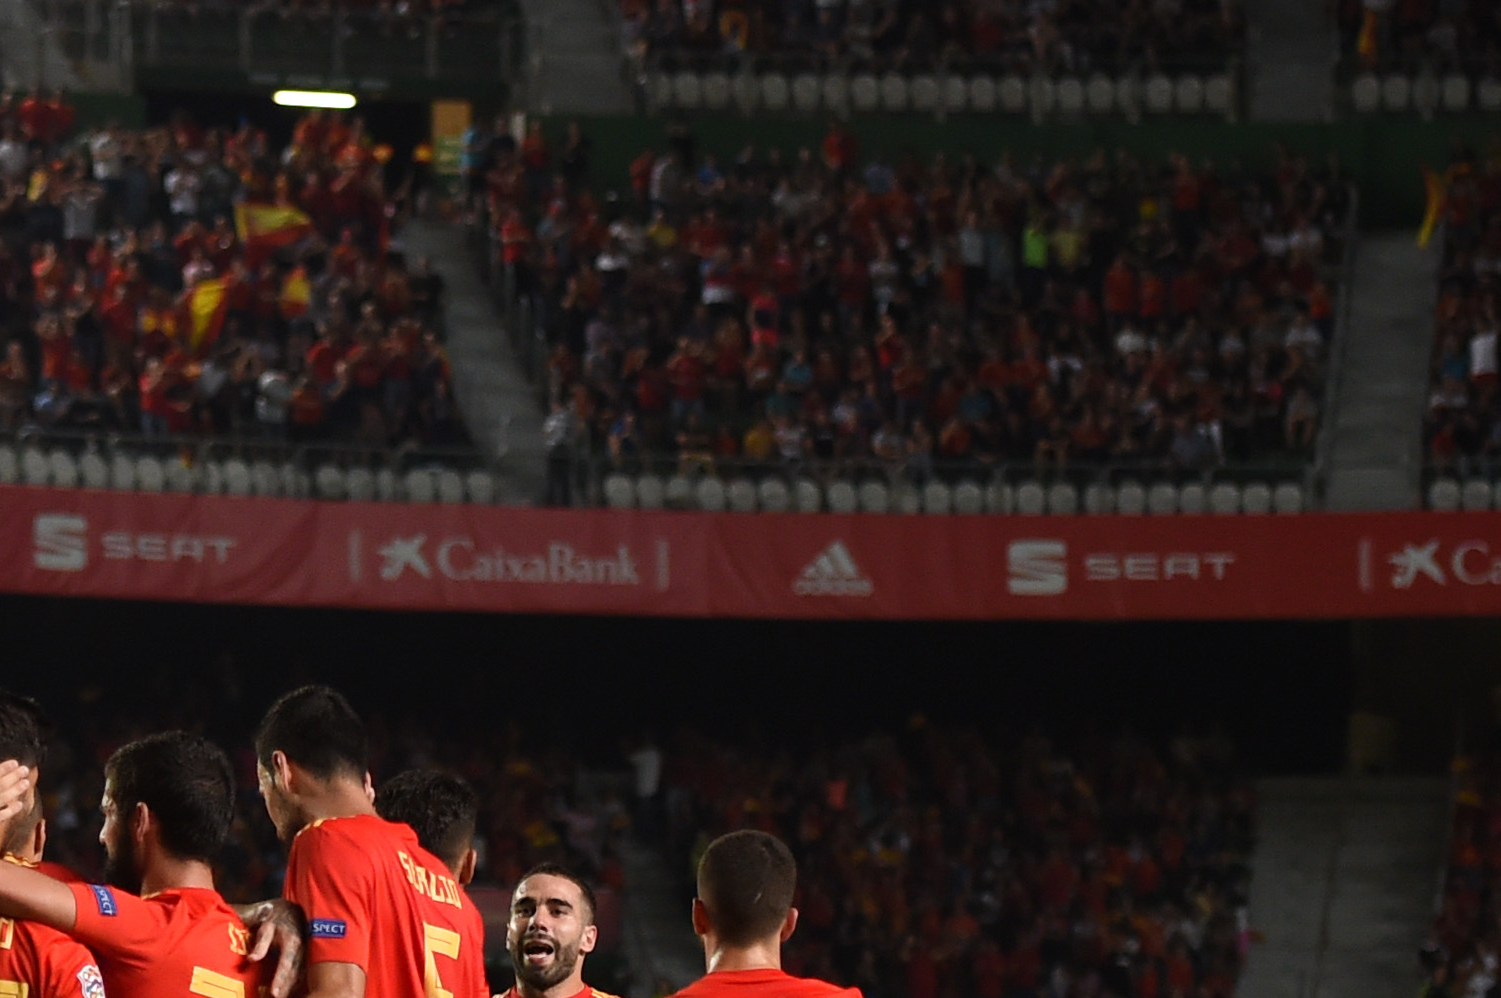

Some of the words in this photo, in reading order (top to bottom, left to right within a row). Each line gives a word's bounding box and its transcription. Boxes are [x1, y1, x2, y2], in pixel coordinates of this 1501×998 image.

[100, 532, 236, 564] SEAT
[437, 536, 640, 585] CaixaBank
[1084, 551, 1236, 581] SEAT
[312, 923, 346, 935] SPECT
